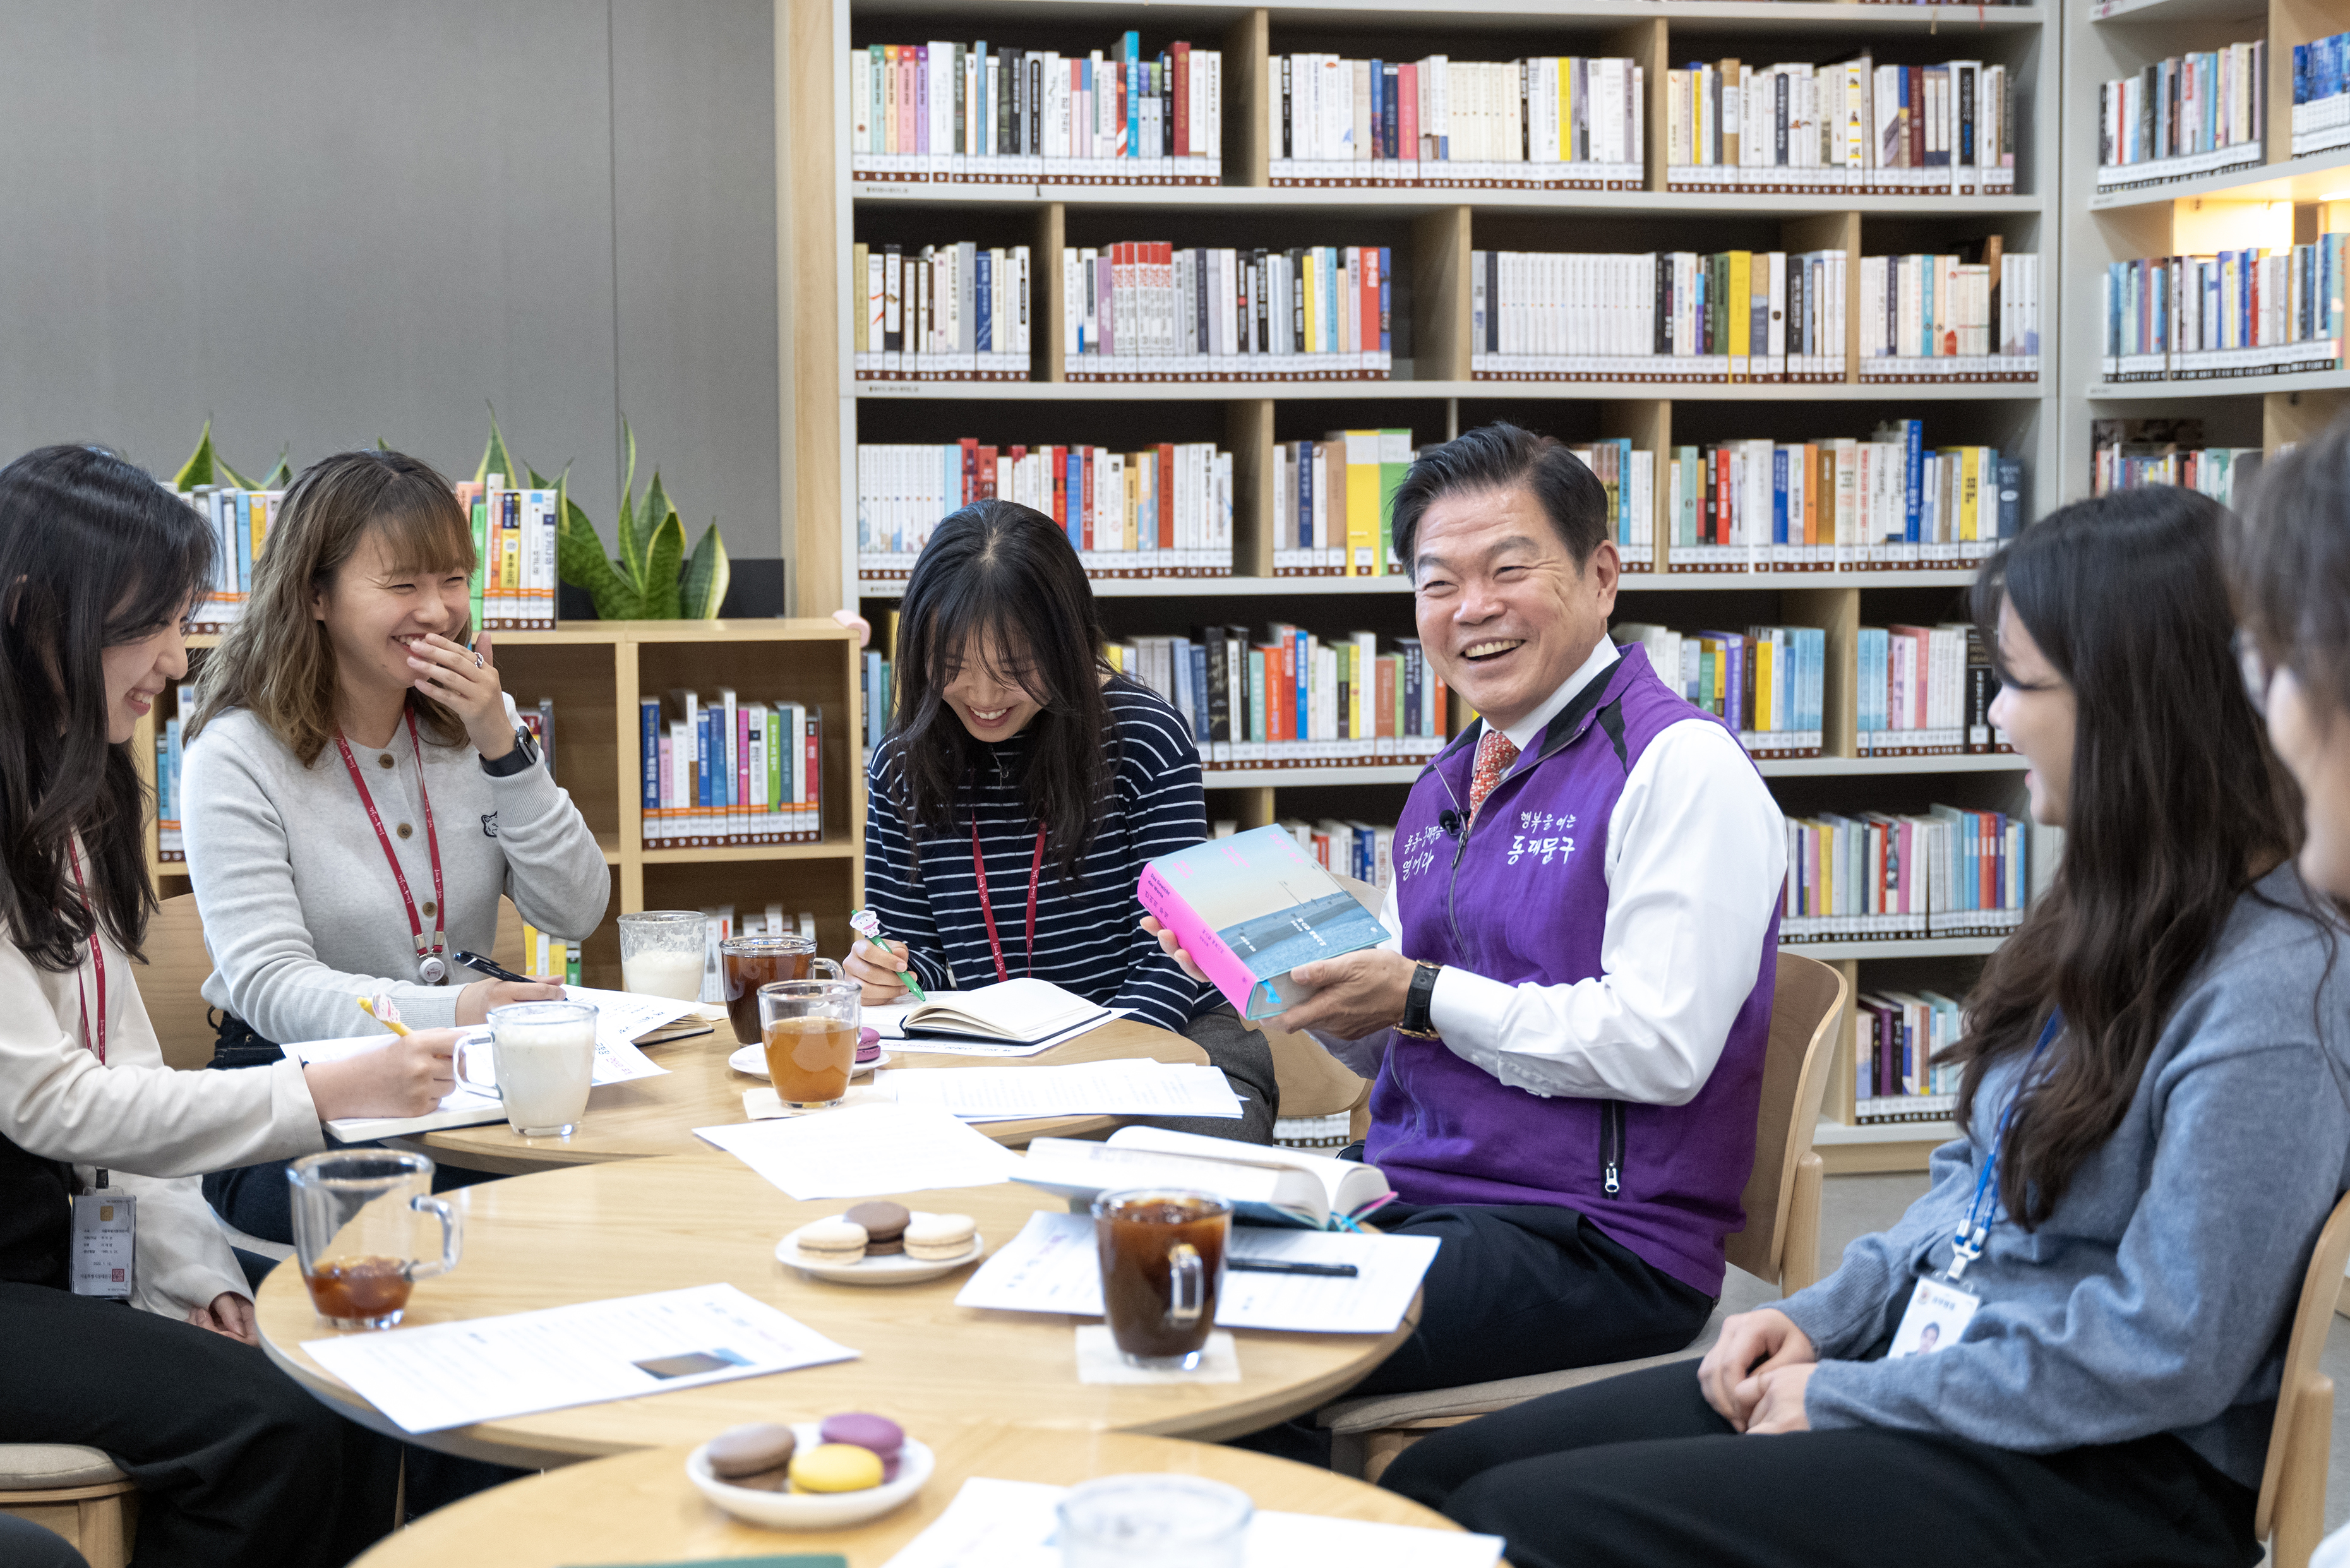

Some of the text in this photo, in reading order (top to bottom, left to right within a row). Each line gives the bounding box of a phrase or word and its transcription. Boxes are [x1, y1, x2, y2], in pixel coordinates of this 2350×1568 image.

[1521, 811, 1576, 834] 행복을 여는
[1507, 835, 1576, 865] 동대문구
[1402, 849, 1434, 882] 열어라
[1153, 886, 1164, 899] Worte
[1156, 880, 1170, 896] Gewicht
